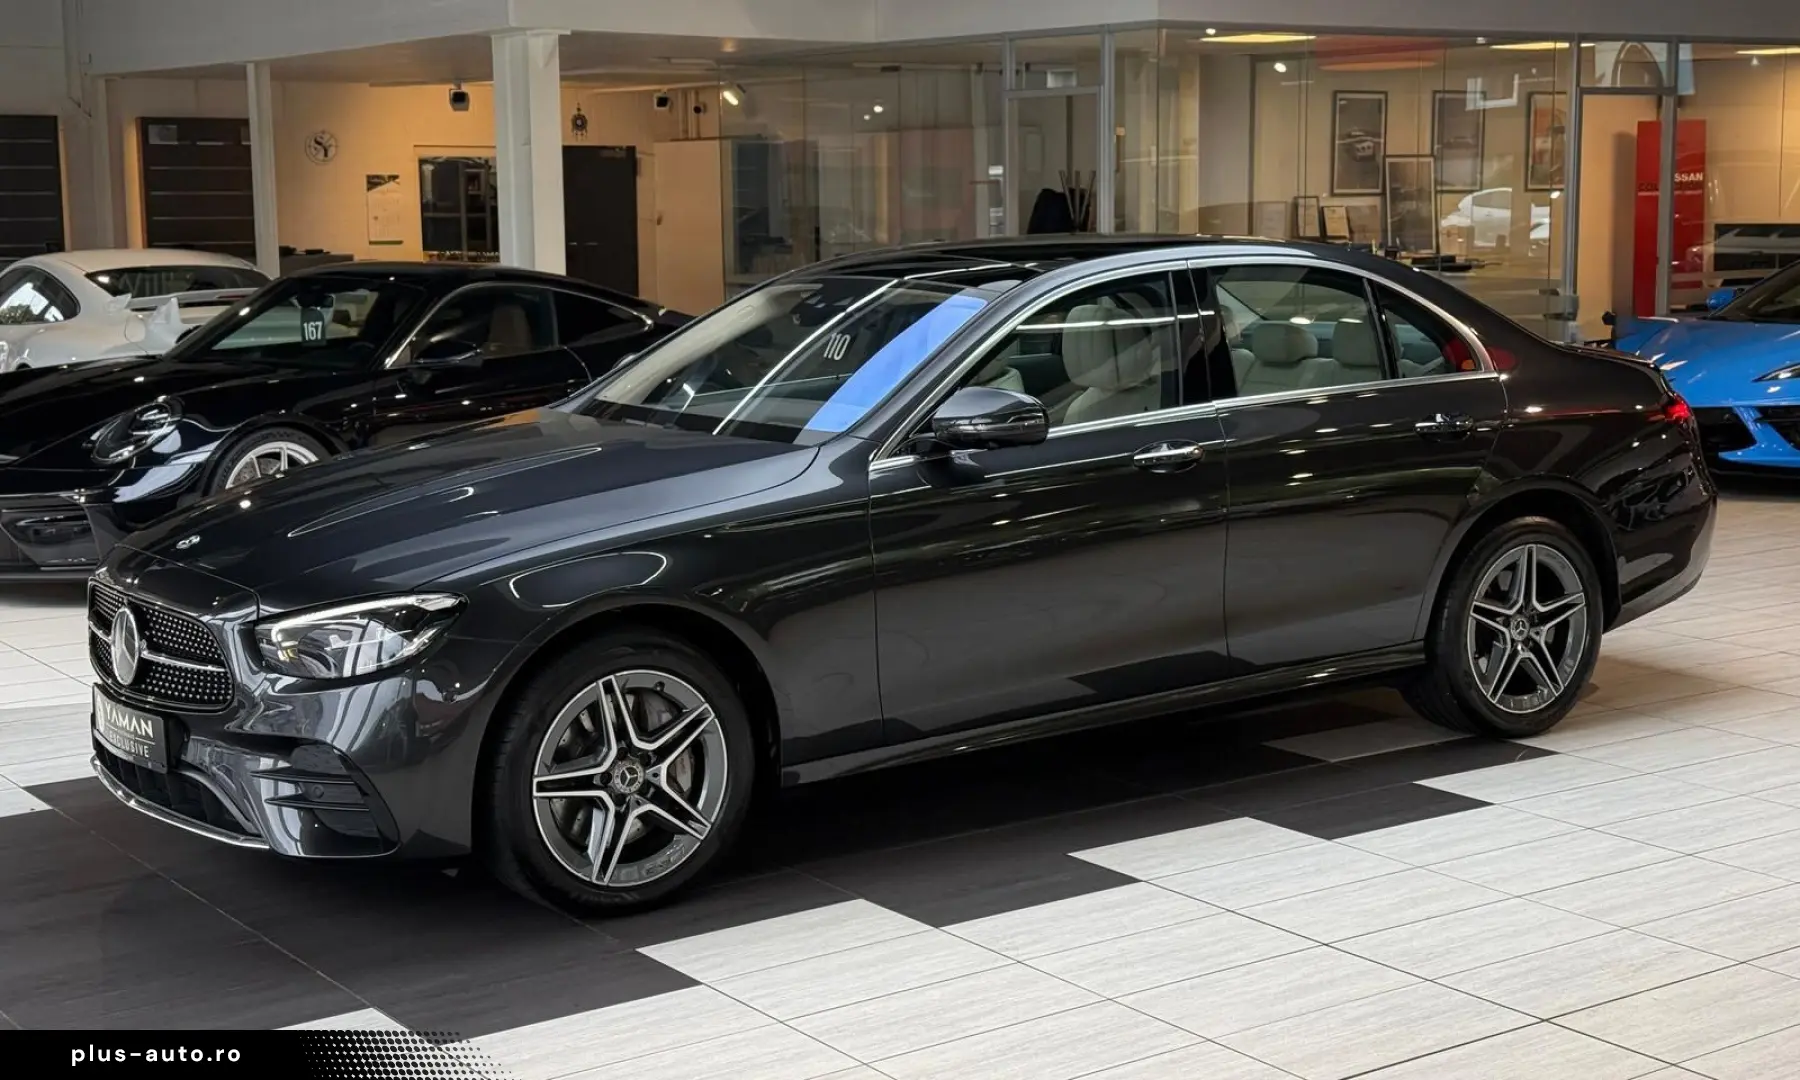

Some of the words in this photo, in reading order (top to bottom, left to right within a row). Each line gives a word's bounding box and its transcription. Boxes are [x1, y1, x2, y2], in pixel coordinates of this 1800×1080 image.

[1674, 172, 1704, 182] SSAN
[303, 321, 323, 341] 167
[823, 332, 851, 361] 110
[104, 701, 154, 738] YAMAN
[106, 729, 150, 757] EXCLUSIVE
